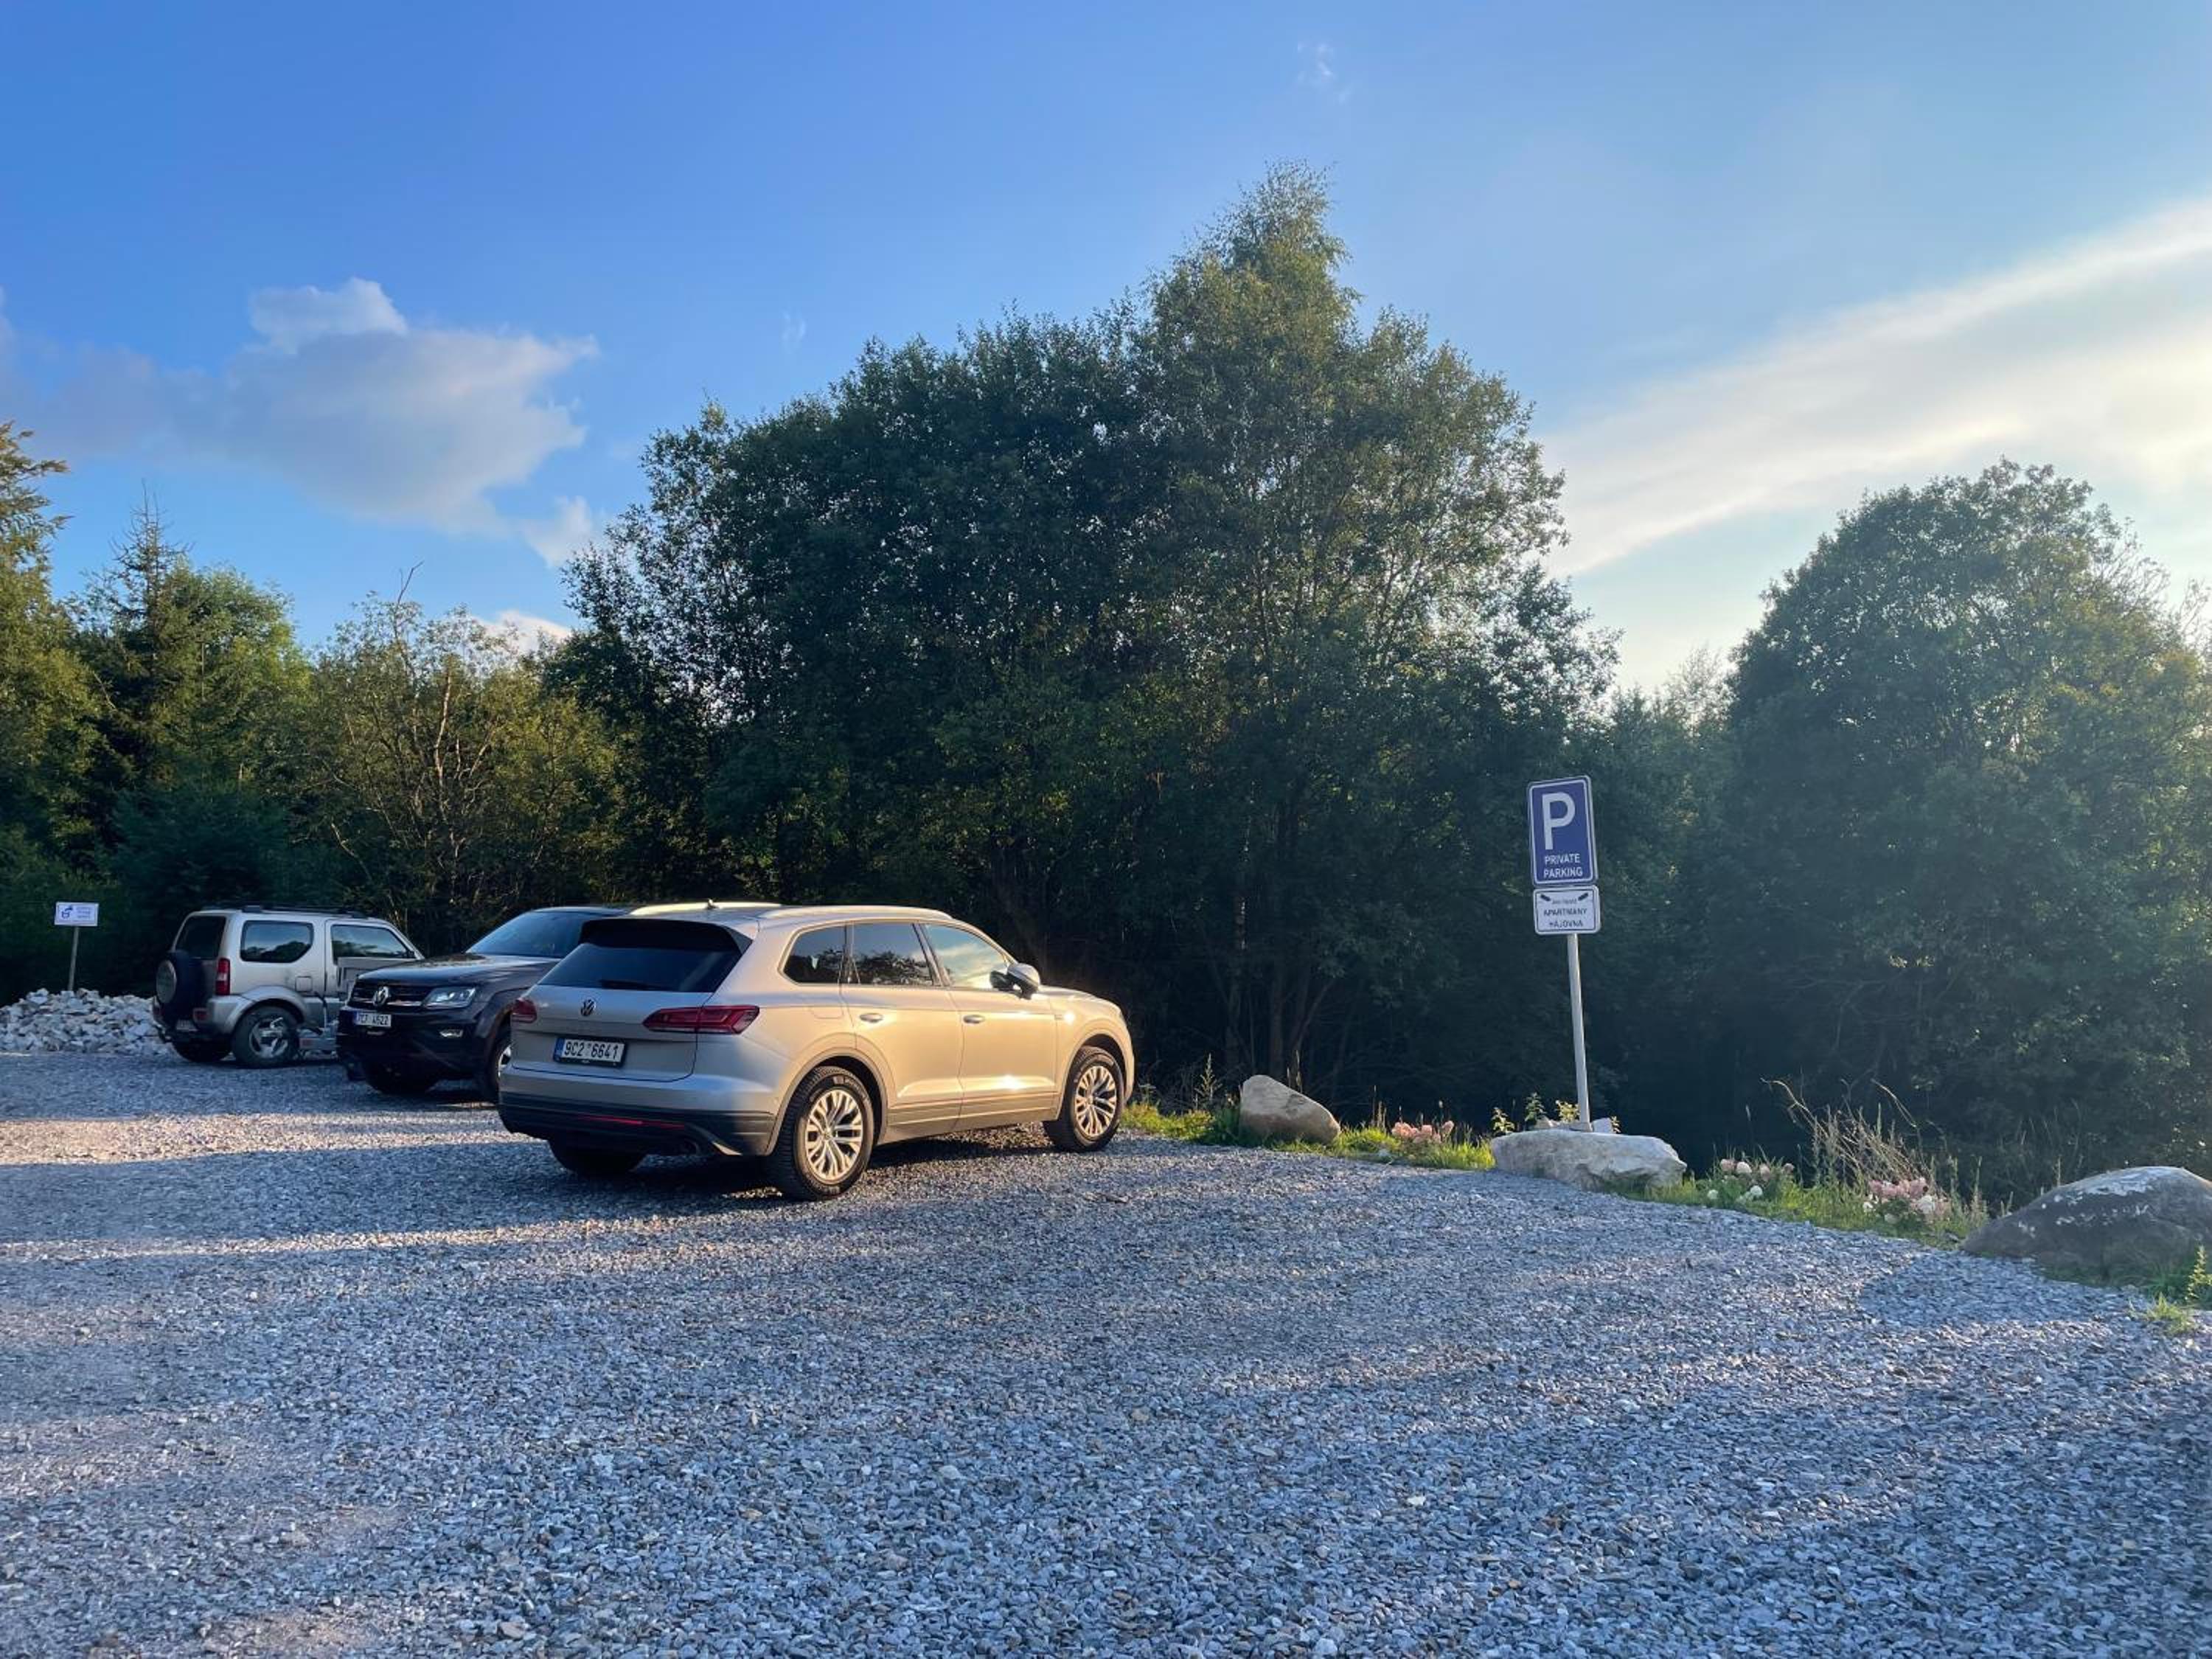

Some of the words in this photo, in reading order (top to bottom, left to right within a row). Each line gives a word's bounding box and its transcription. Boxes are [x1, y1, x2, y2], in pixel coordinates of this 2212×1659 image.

[1542, 792, 1576, 850] P
[1545, 853, 1580, 865] PRIVATE
[1544, 866, 1583, 878] PARKING
[591, 1043, 618, 1060] 6641
